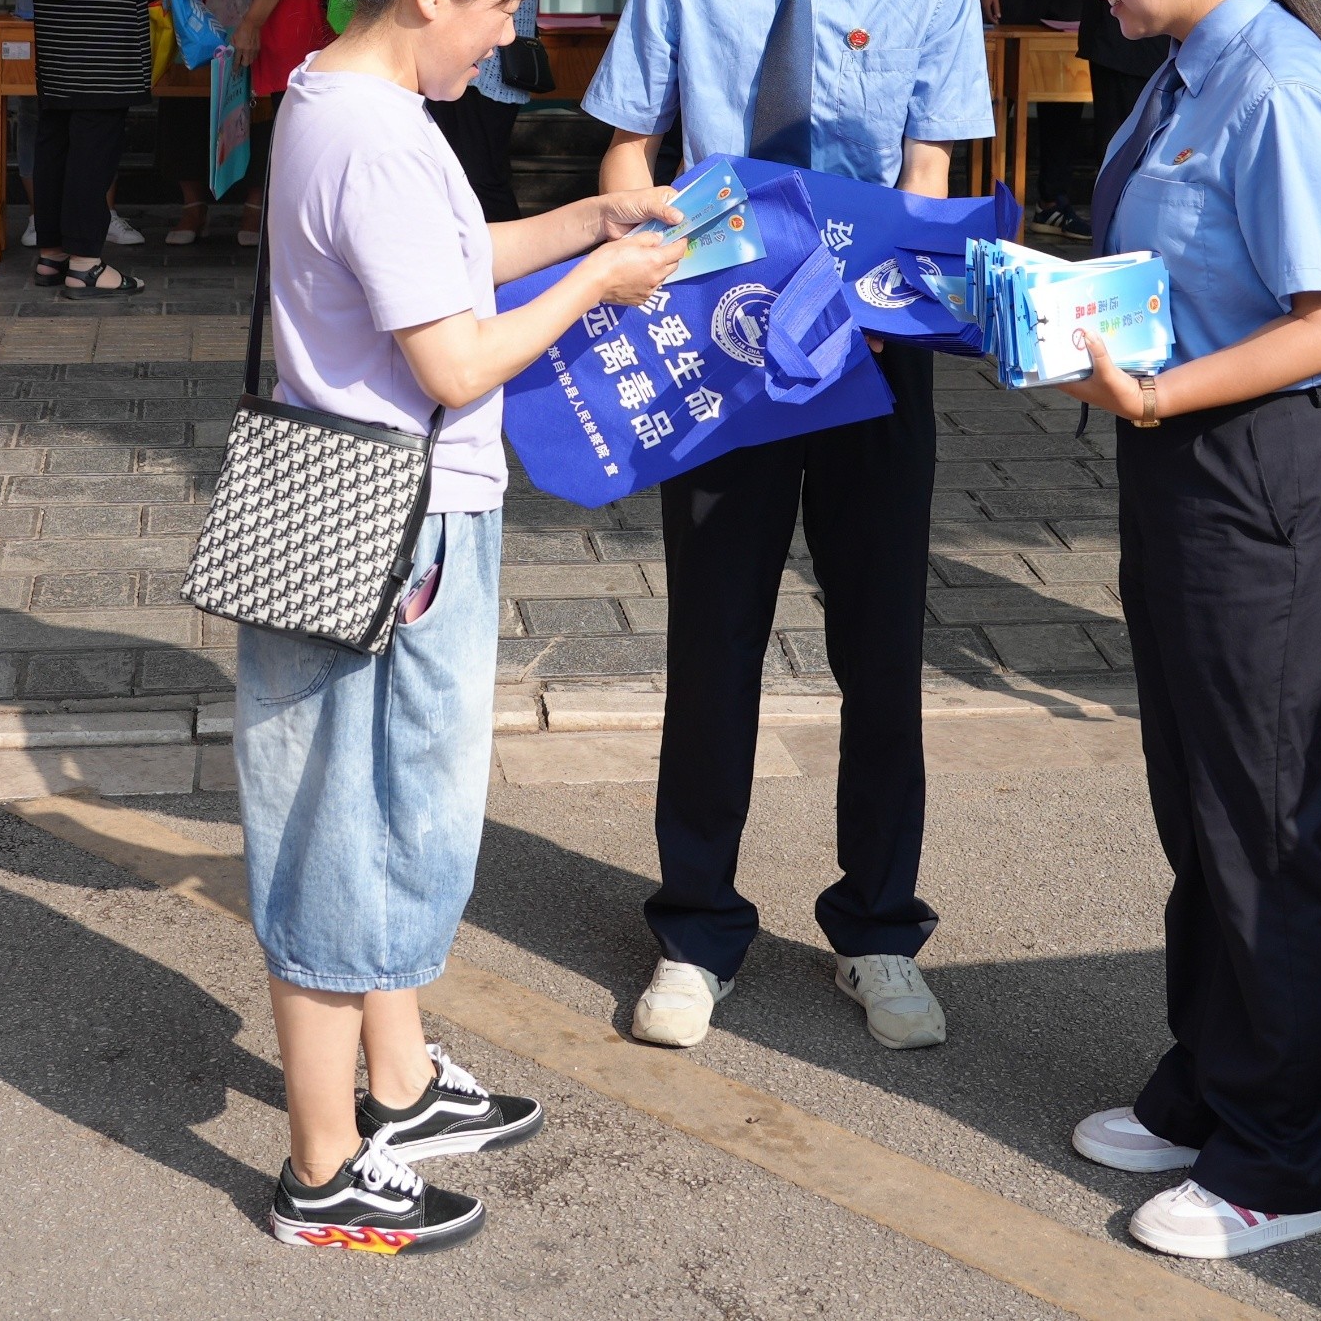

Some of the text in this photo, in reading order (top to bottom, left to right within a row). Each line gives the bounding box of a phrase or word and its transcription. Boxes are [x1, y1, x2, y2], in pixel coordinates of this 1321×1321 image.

[1075, 295, 1119, 320] 远离毒品
[1100, 310, 1144, 334] 珍爱生命
[604, 461, 619, 477] 宣
